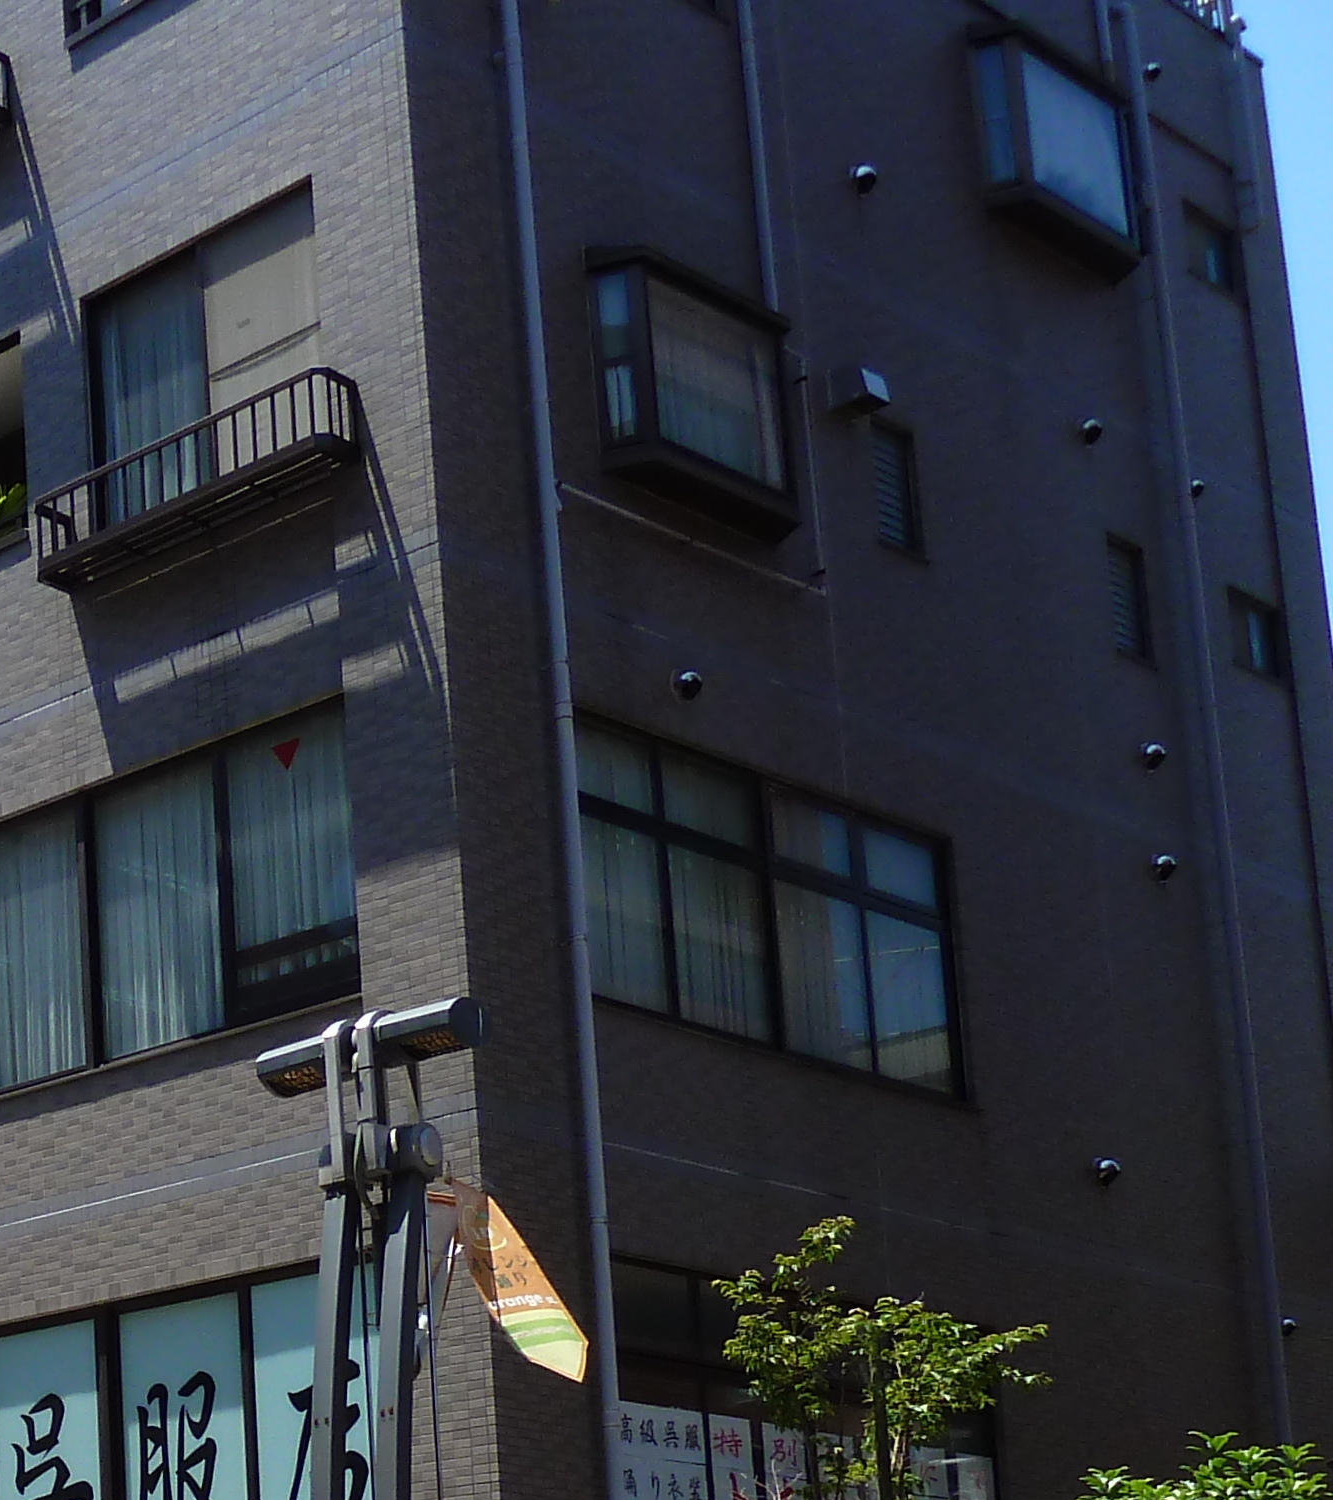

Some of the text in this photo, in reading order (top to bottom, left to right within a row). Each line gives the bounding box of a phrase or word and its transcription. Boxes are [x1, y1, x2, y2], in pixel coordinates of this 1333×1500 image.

[488, 1293, 544, 1311] orange
[619, 1413, 702, 1451] 高級呉服
